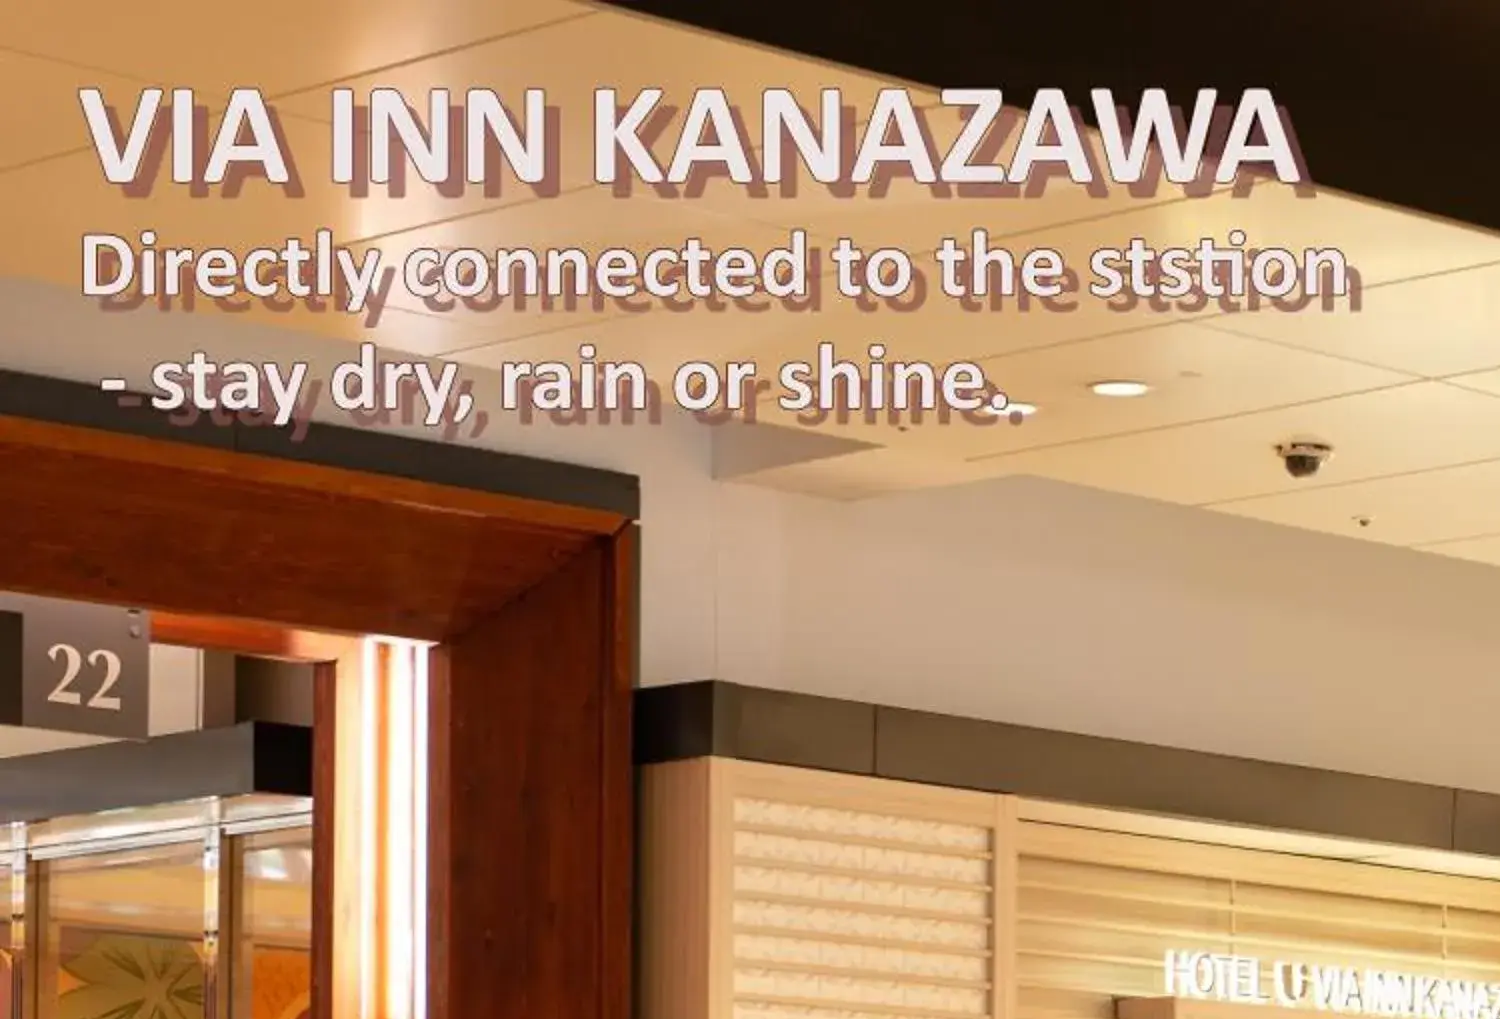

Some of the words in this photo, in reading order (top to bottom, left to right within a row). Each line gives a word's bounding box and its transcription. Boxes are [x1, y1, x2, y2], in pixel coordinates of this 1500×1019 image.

[47, 643, 121, 711] 22
[1165, 949, 1271, 1005] HOTEL
[1314, 964, 1365, 1014] VIA
[1365, 969, 1416, 1019] INN
